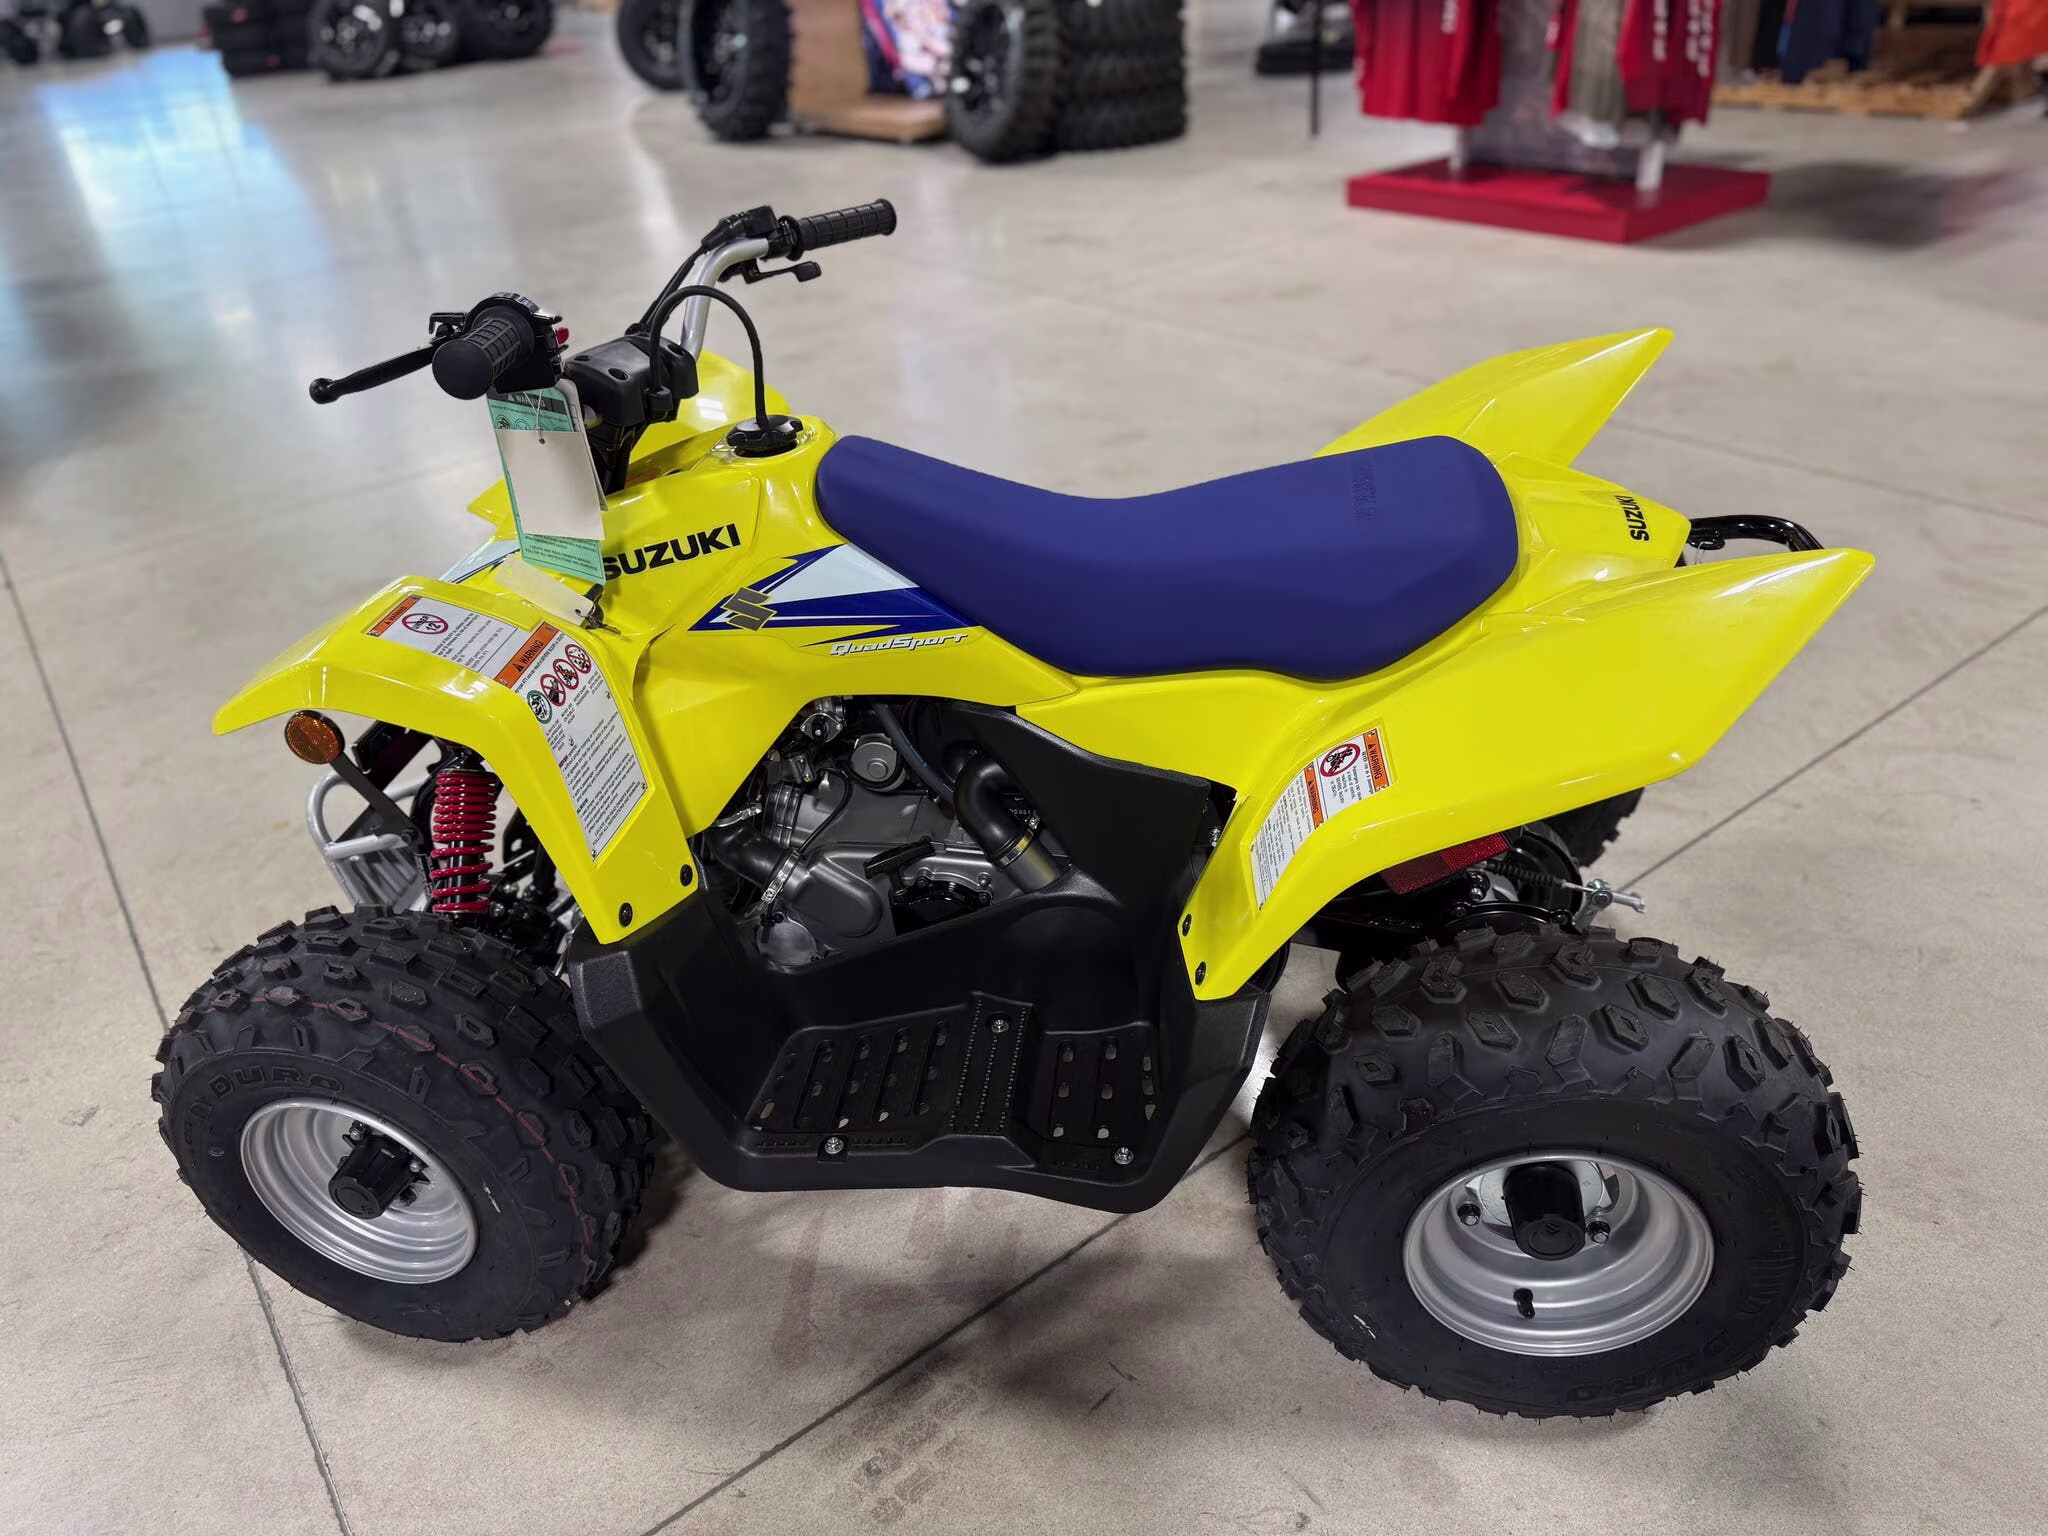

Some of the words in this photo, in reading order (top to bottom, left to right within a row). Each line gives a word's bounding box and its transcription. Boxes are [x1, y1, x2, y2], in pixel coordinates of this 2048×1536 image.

[1614, 495, 1650, 541] SUZUKI
[604, 523, 741, 581] SUZUKI
[425, 622, 440, 630] 12
[519, 639, 544, 665] WARNING
[829, 632, 969, 657] QuadSport
[1369, 749, 1382, 780] WARNING
[1309, 785, 1318, 814] WARNING
[207, 1065, 344, 1099] DURO
